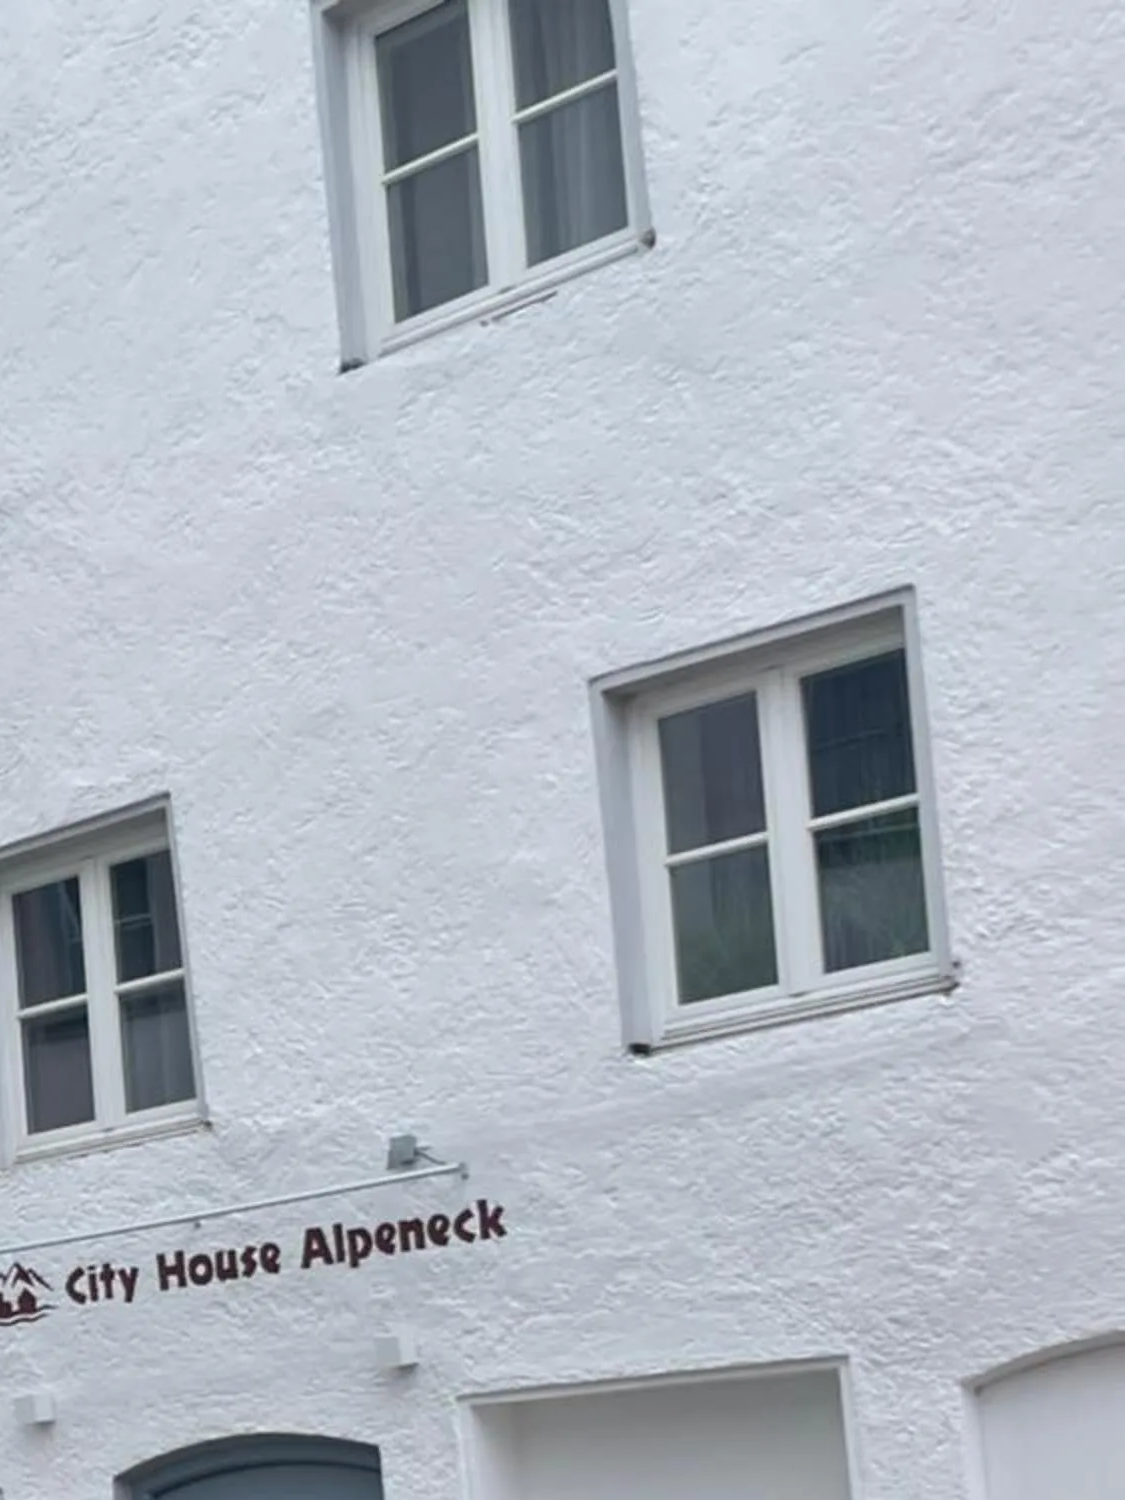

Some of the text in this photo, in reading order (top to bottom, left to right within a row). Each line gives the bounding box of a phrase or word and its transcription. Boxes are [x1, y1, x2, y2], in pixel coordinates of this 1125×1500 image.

[65, 1199, 508, 1304] City House Alpeneck
